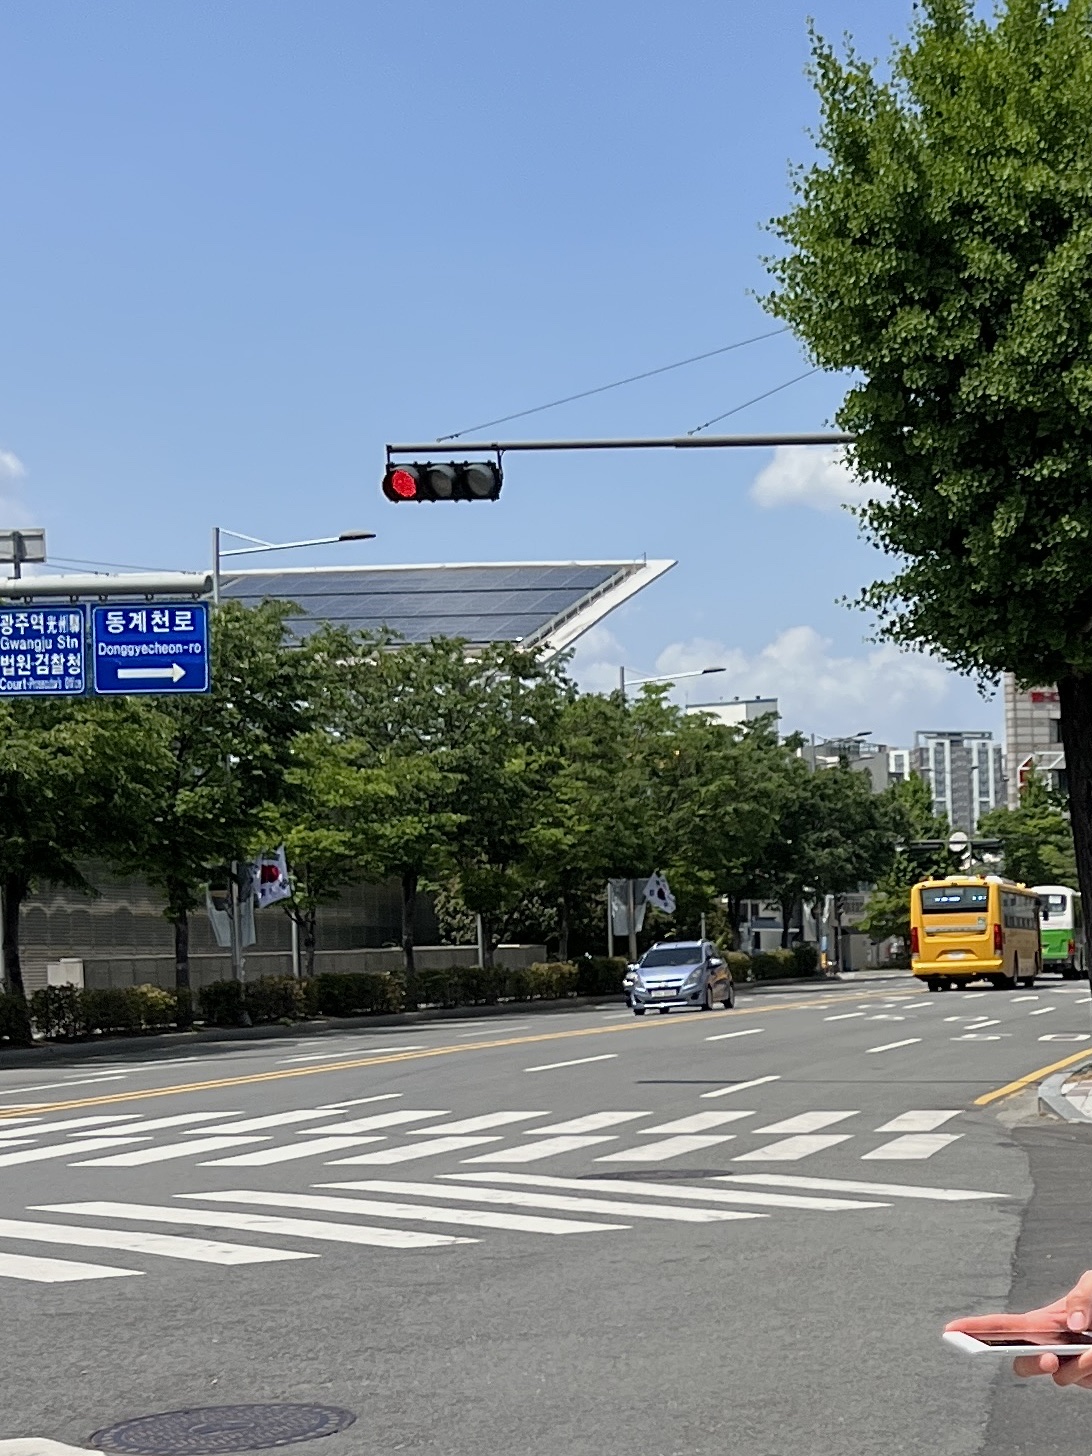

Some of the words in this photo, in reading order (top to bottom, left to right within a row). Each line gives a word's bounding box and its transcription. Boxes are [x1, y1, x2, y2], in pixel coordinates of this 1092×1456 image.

[105, 610, 194, 633] 동계천로
[0, 636, 52, 652] Gwangju
[57, 635, 78, 649] Stn
[98, 642, 202, 657] Donggyecheon-ro
